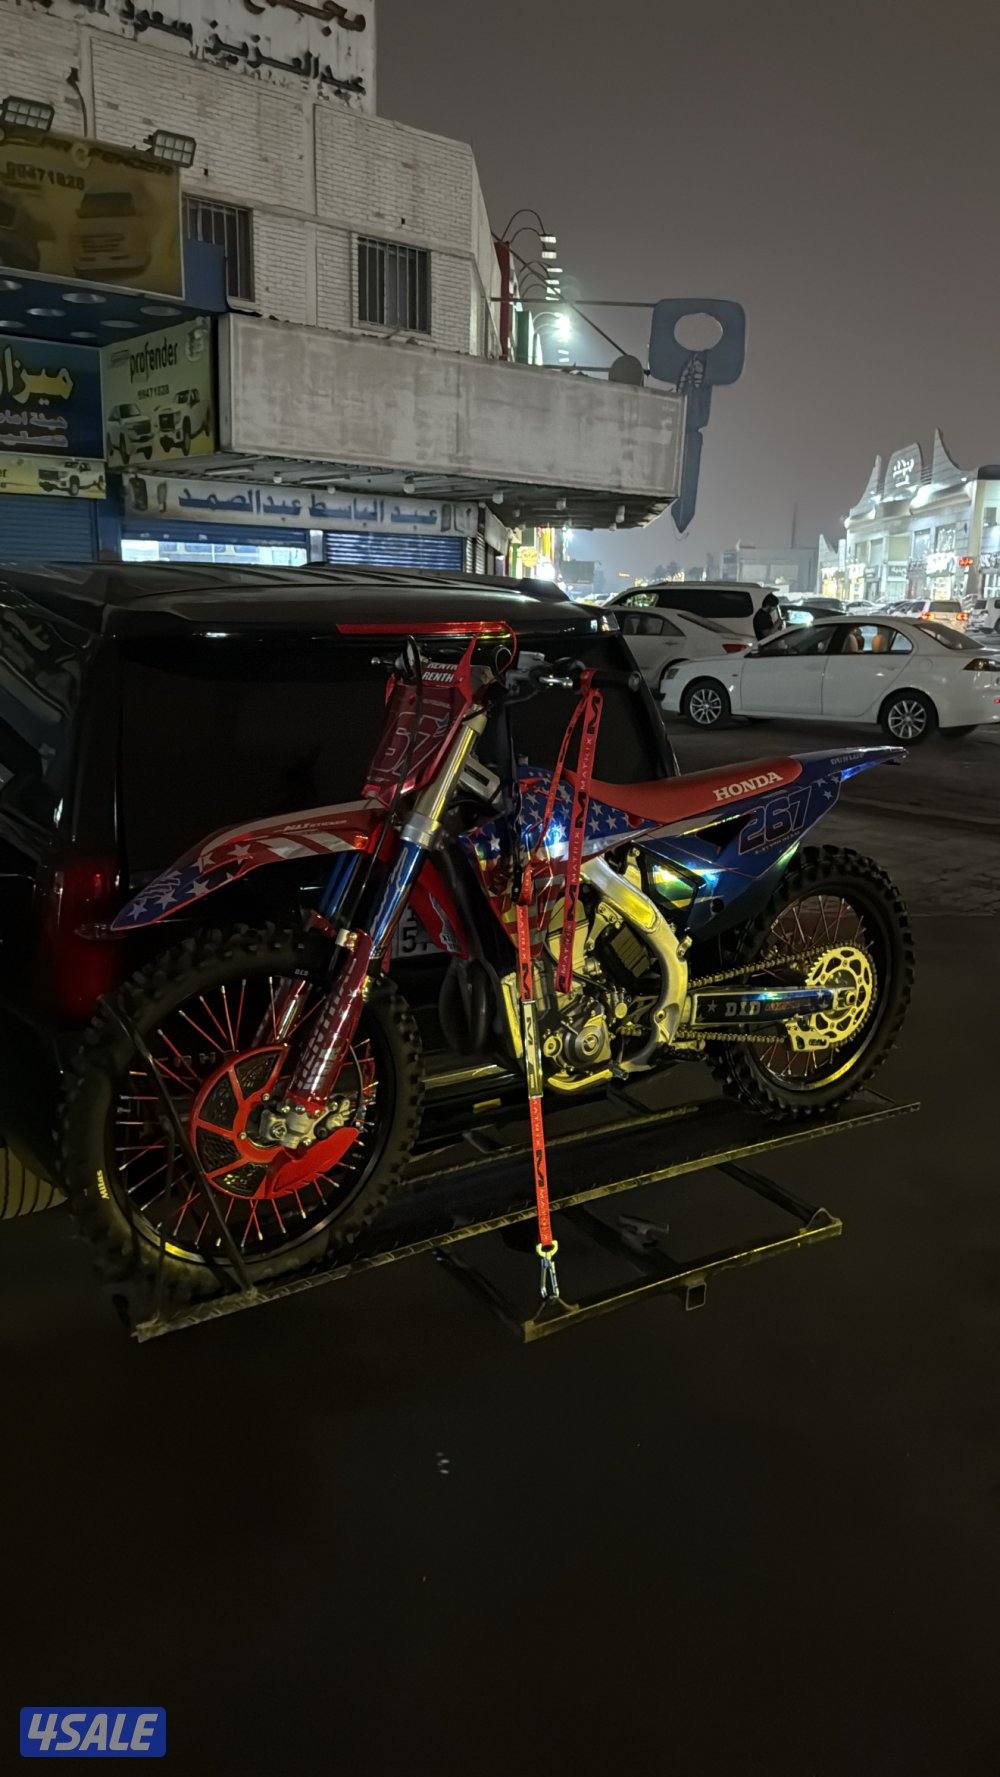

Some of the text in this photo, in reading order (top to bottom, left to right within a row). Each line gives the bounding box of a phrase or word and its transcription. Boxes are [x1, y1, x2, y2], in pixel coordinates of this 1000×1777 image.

[0, 347, 74, 404] ميزا
[129, 337, 177, 384] profender
[712, 771, 784, 802] HONDA
[738, 785, 812, 856] 267
